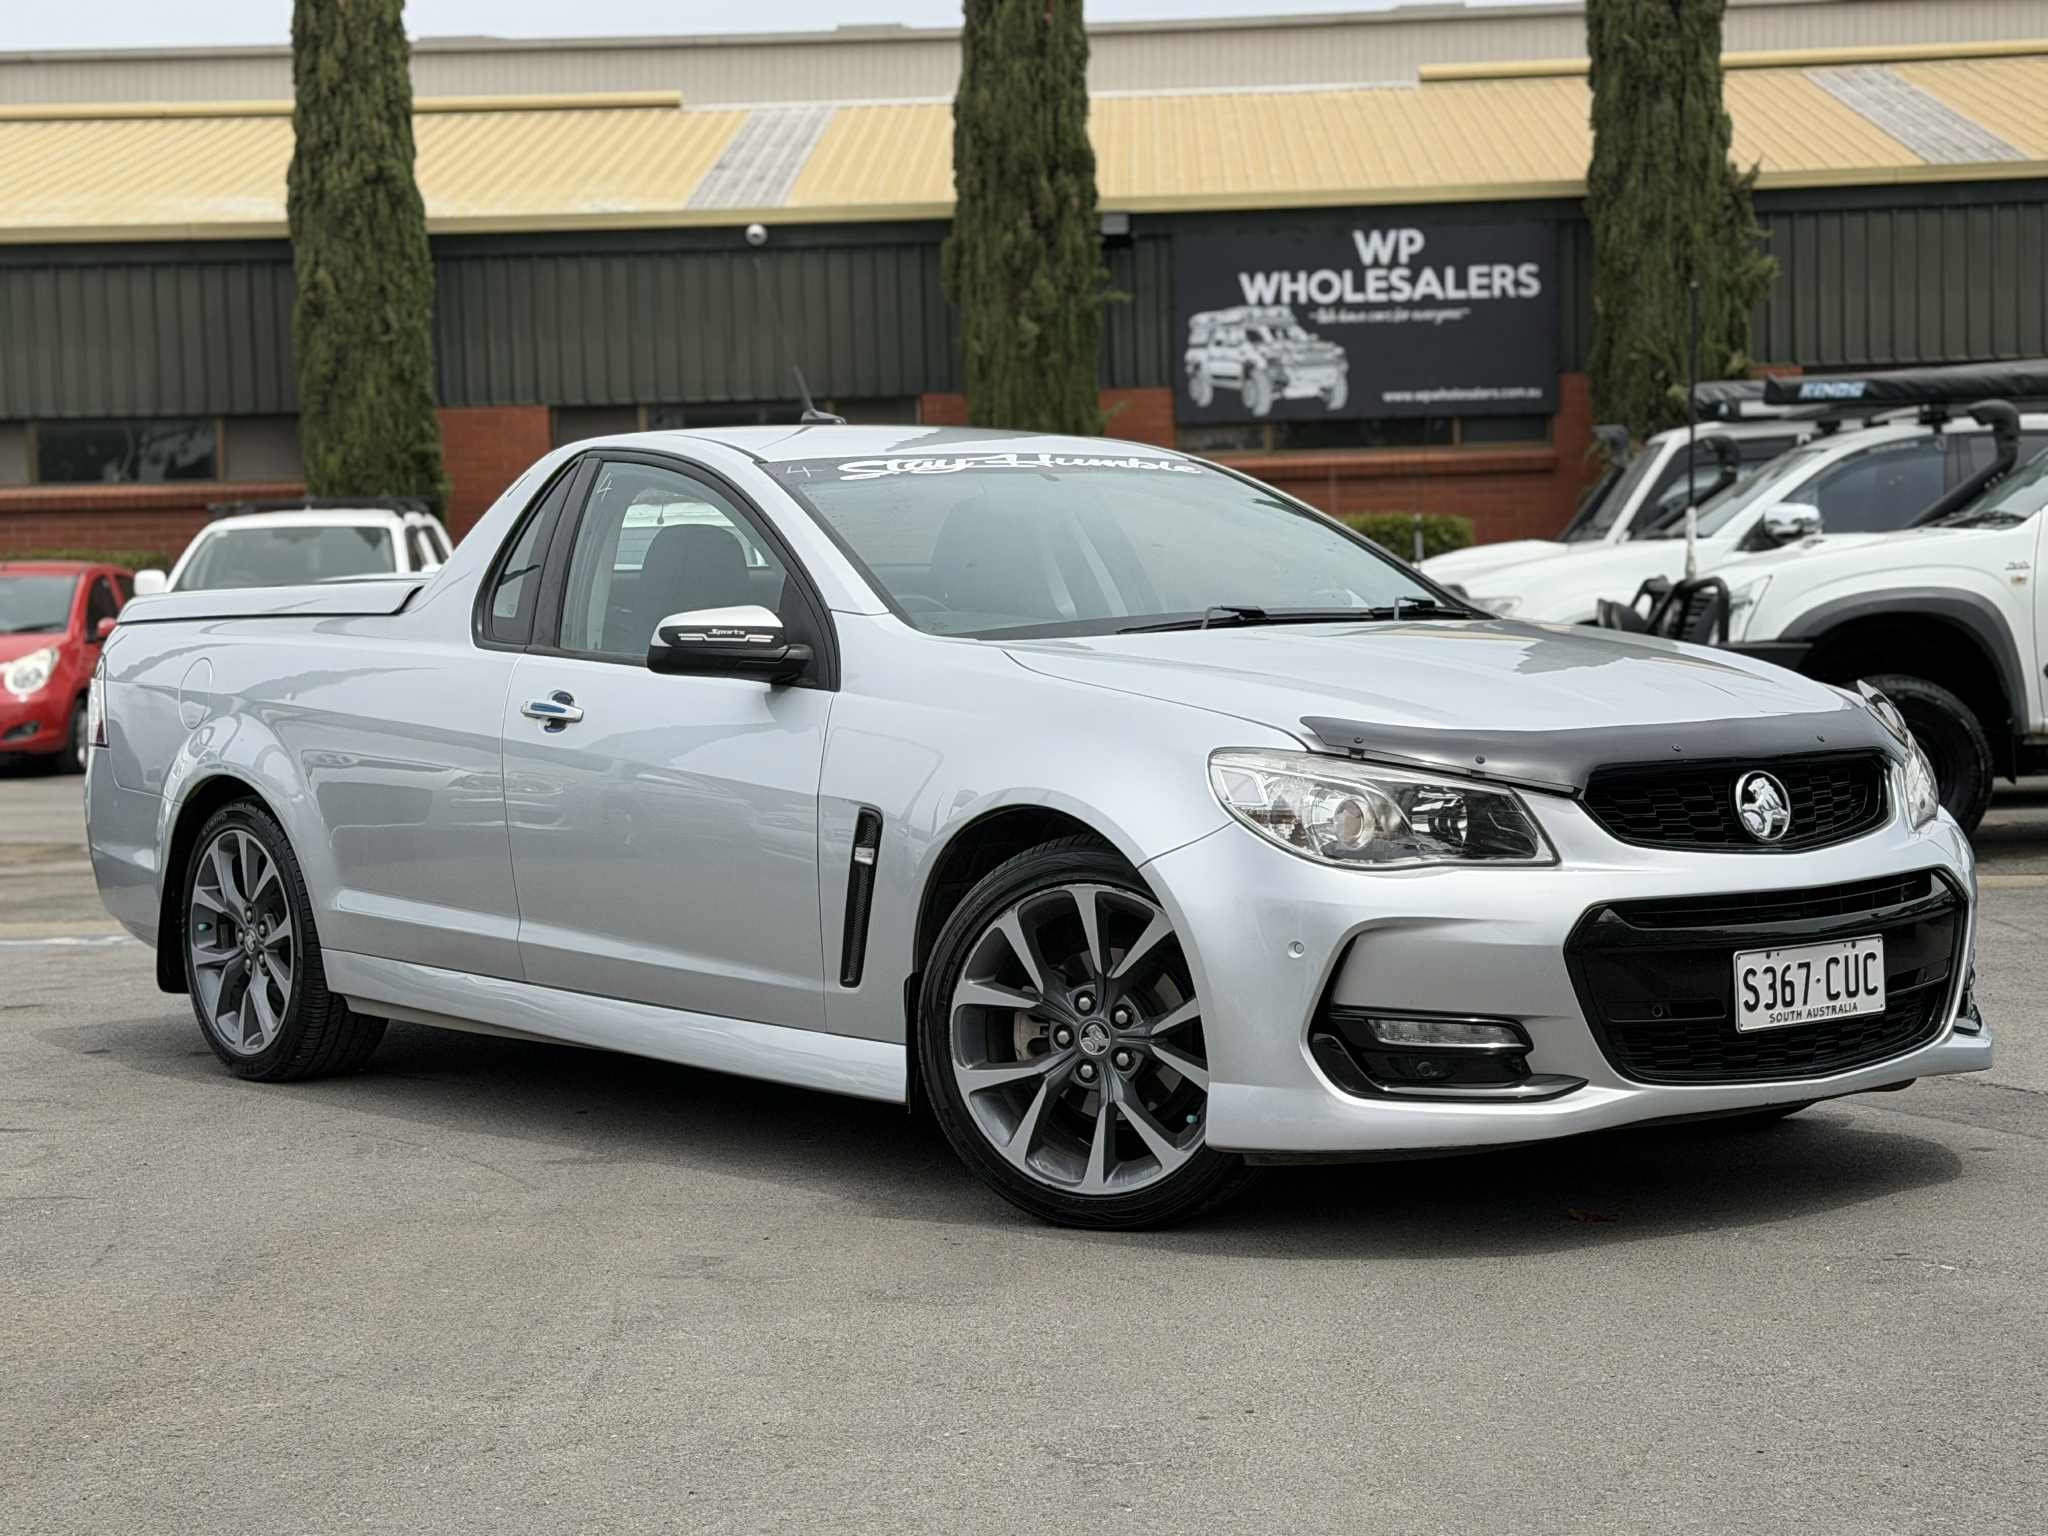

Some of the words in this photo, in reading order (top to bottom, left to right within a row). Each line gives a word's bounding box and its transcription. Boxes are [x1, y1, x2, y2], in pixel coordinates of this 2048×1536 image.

[1352, 229, 1425, 266] WP
[1238, 263, 1542, 305] WHOLESALERS
[1769, 1009, 1802, 1024] SOUTH
[1806, 1002, 1858, 1019] AUSTRALIA
